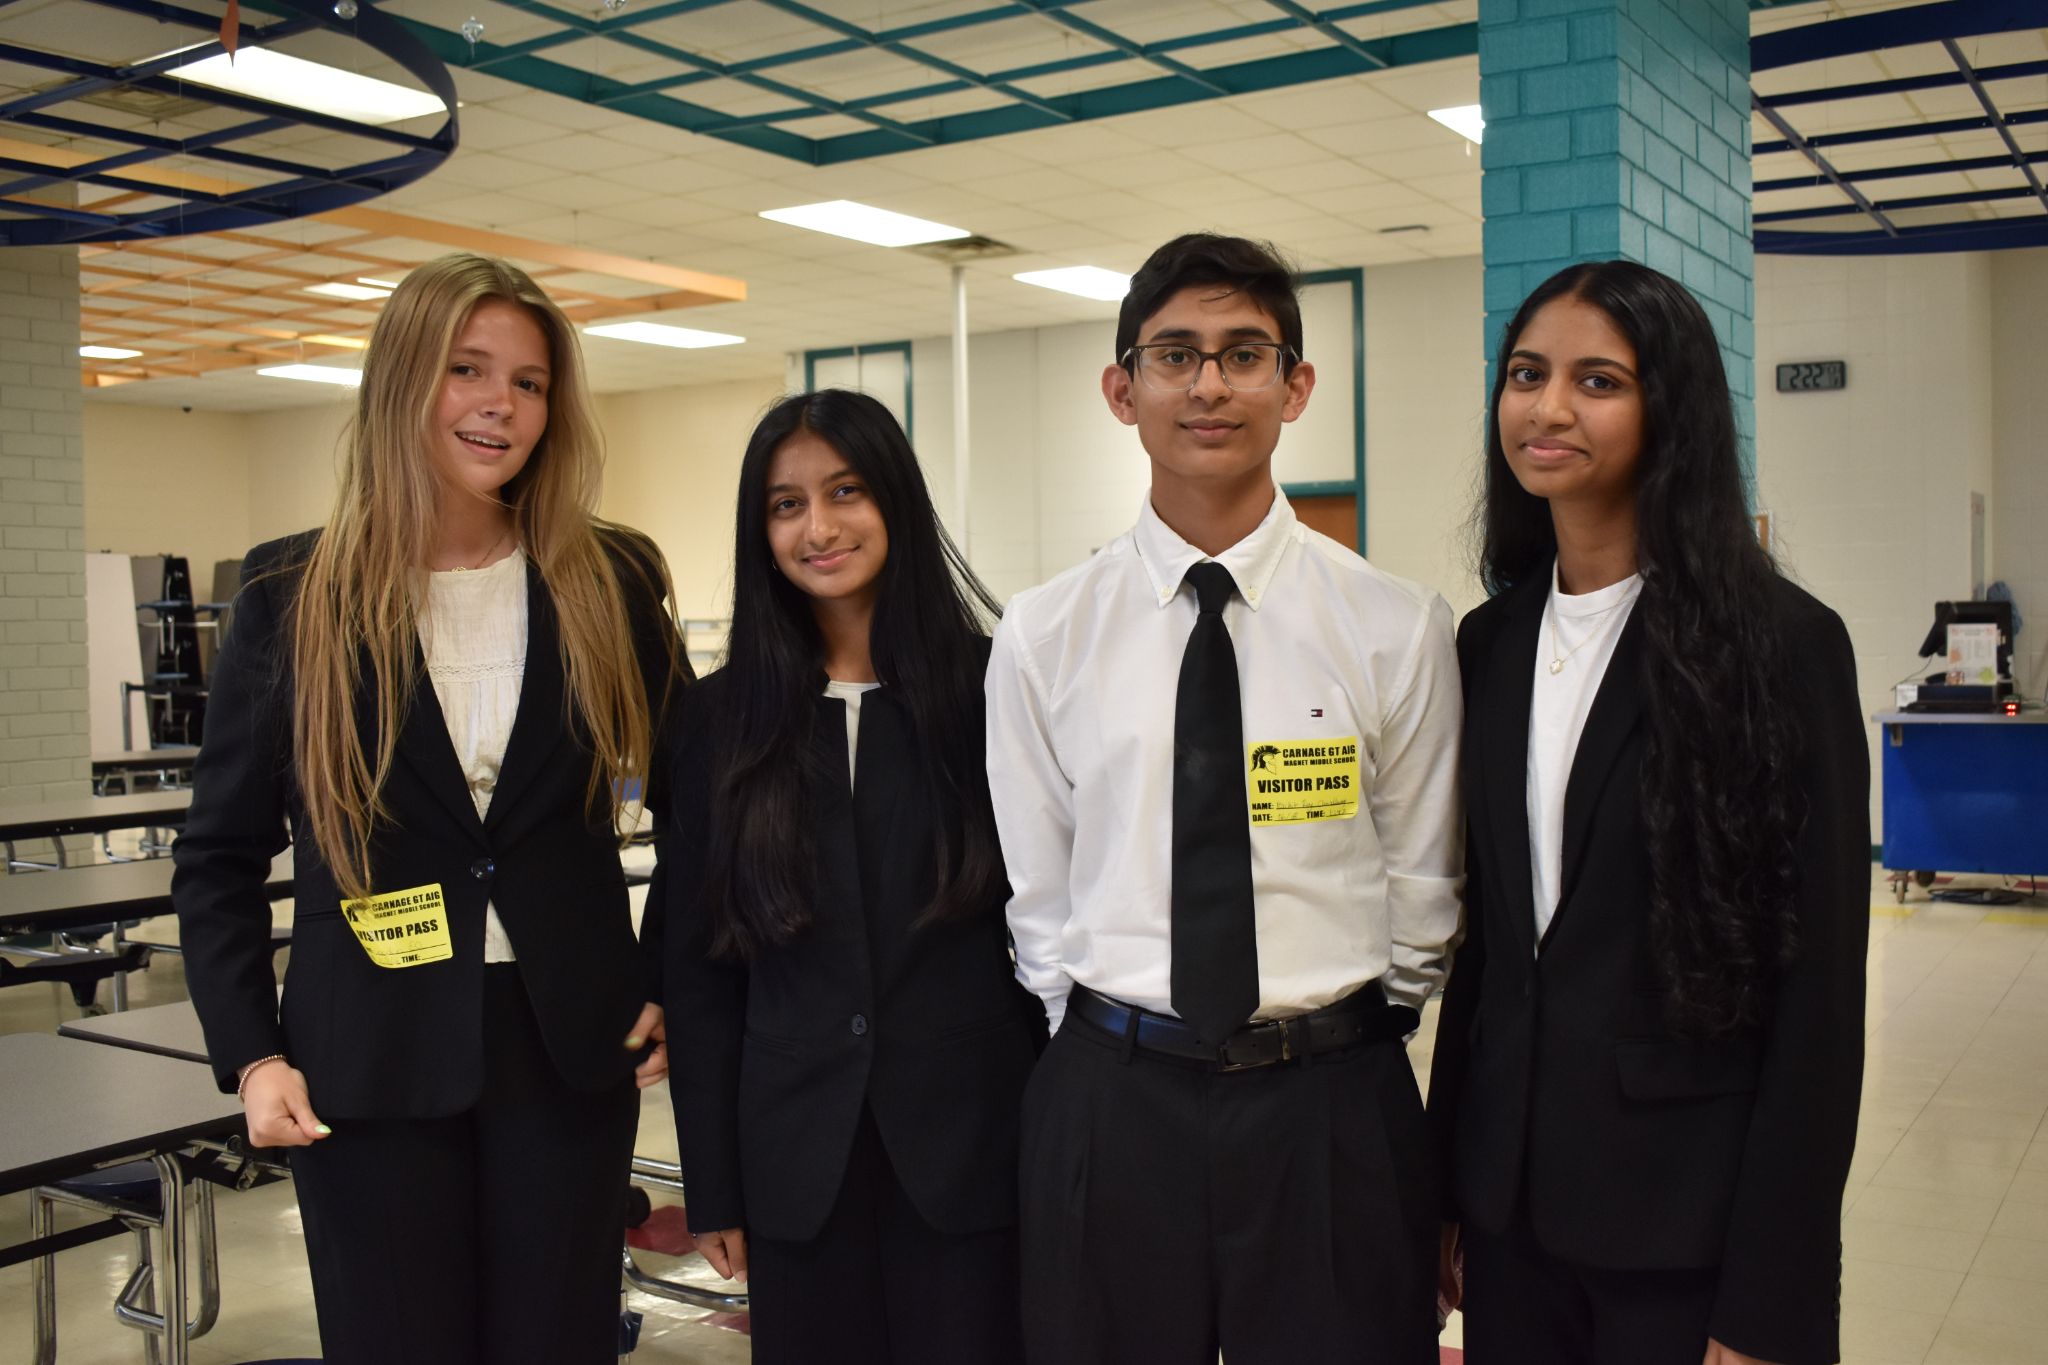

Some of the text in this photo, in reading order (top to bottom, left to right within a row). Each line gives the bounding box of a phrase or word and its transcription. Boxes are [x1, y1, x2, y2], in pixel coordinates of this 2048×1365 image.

[1283, 745, 1355, 757] CARNAGE GT AIG
[1310, 757, 1333, 765] MIDDLE
[1334, 756, 1355, 764] SCHOOL
[1257, 775, 1349, 793] VISITOR PASS
[1252, 802, 1274, 810] NAME:
[1252, 813, 1272, 822] DATE:
[1306, 810, 1325, 819] TIME:
[372, 891, 440, 911] CARNAGE GT AIG
[398, 905, 418, 914] MIDDLE
[420, 902, 441, 910] SCHOOL
[356, 919, 438, 942] VISITOR PASS
[402, 954, 420, 963] TIME:
